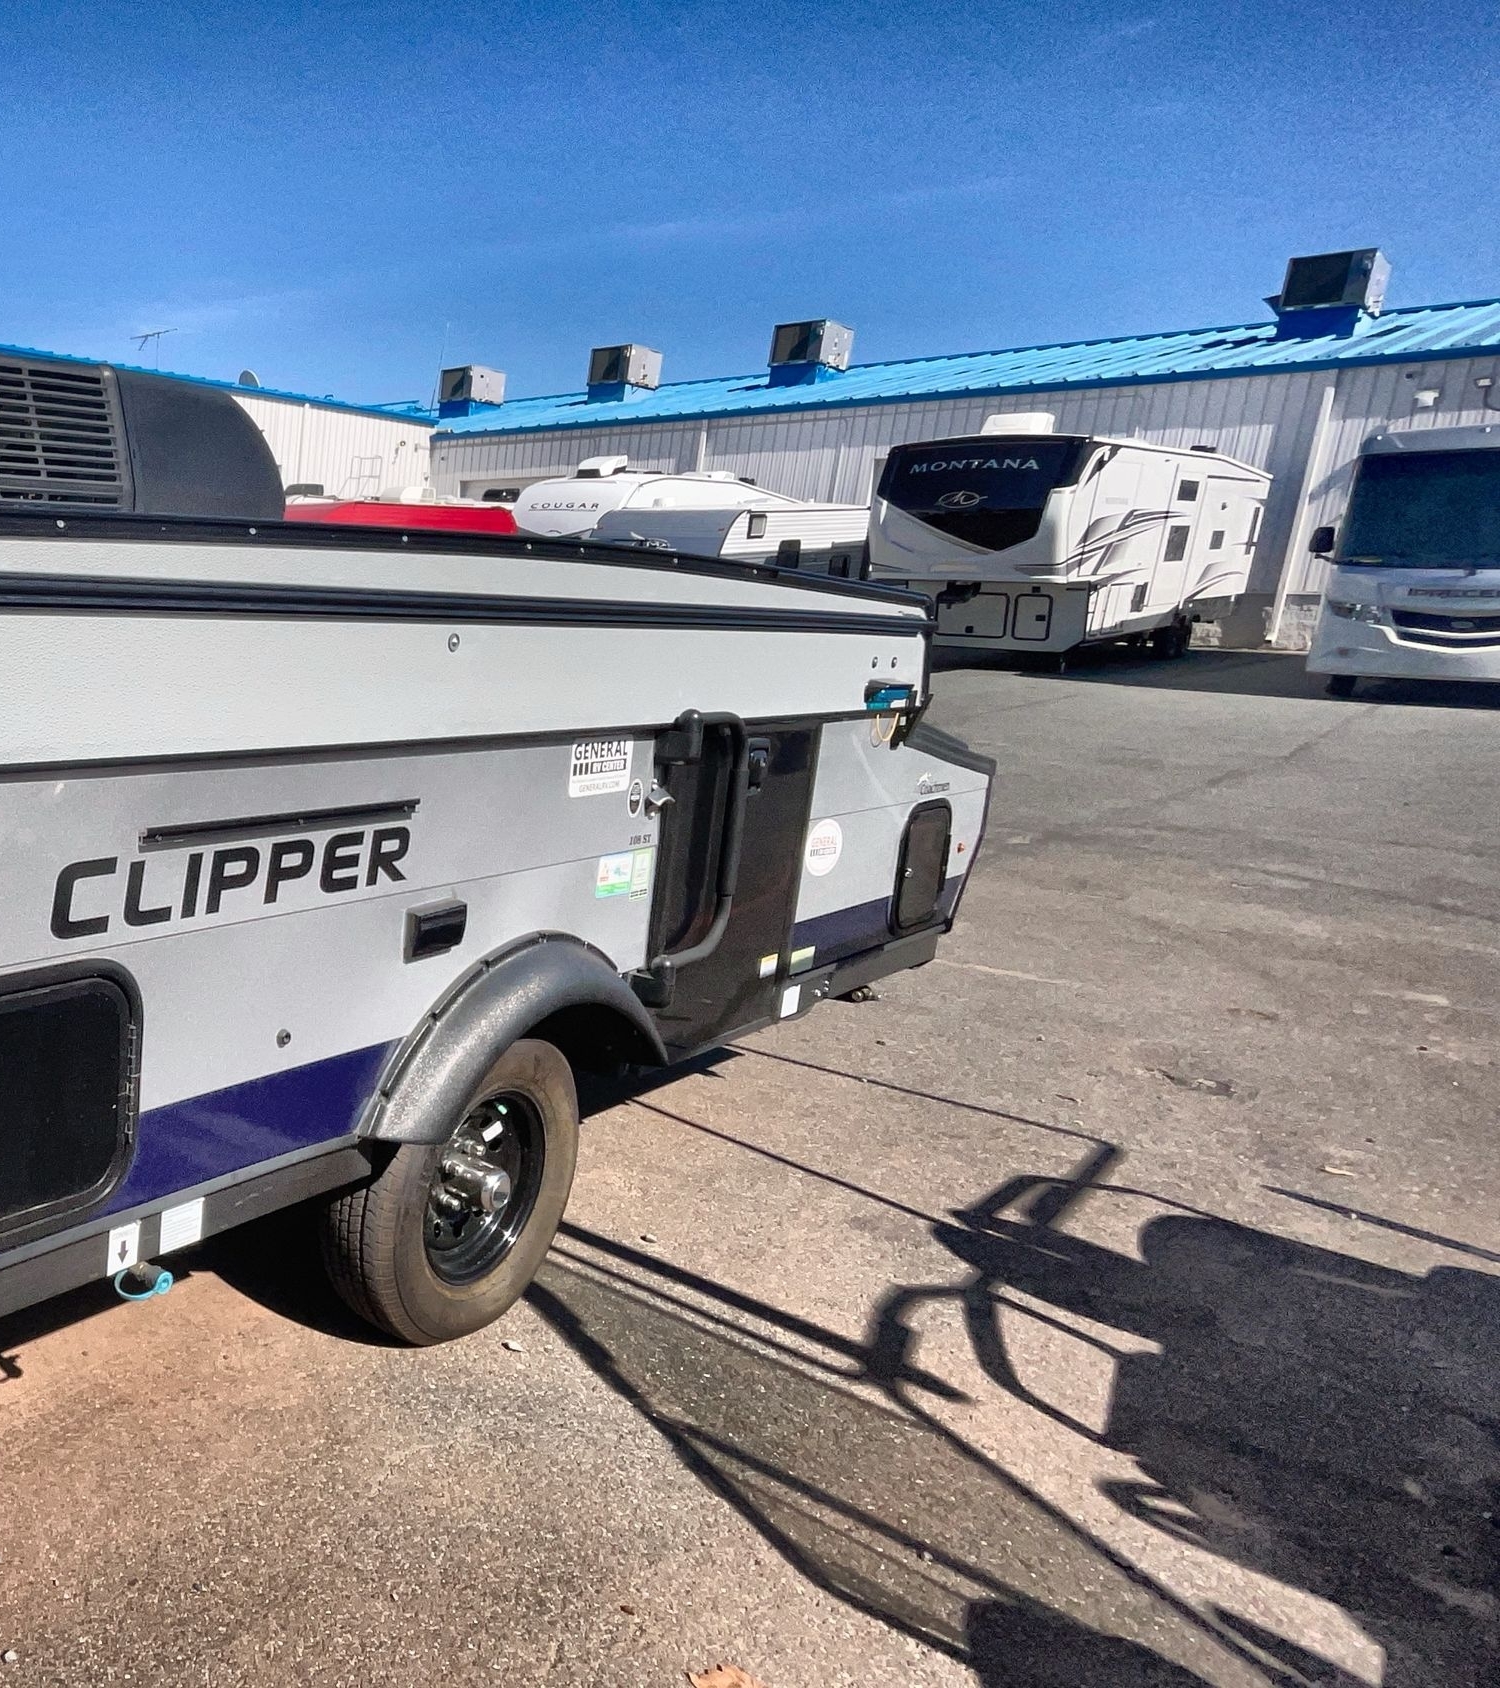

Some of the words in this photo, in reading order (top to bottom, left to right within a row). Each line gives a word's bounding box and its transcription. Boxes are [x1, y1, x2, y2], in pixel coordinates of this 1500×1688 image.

[909, 458, 1040, 475] MONTANA
[574, 740, 628, 761] GENERAL
[49, 826, 411, 940] CLIPPER
